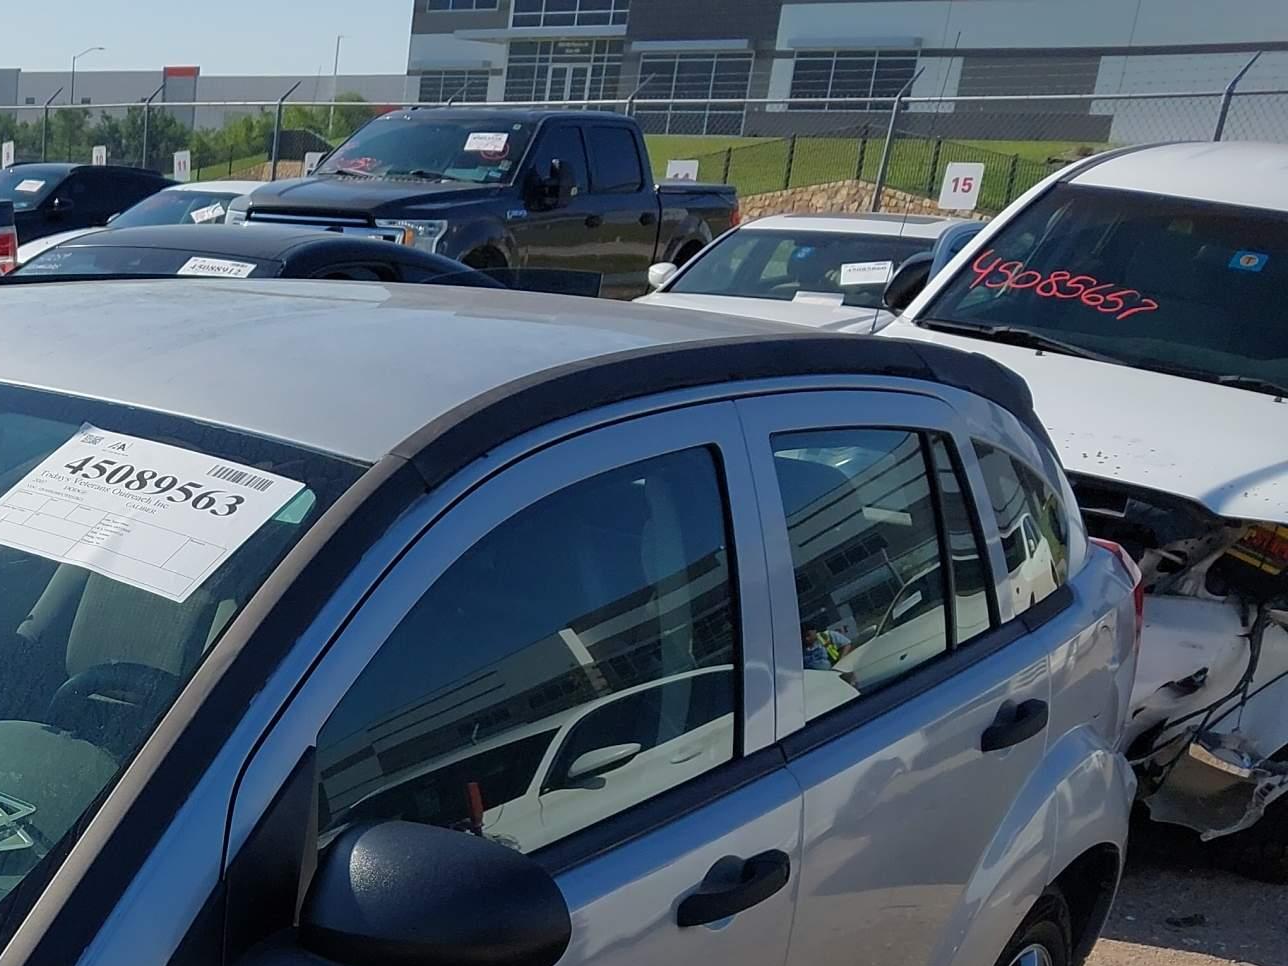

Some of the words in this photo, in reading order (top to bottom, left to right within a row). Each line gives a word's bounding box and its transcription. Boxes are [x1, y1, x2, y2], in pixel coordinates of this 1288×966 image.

[951, 176, 974, 193] 15
[64, 455, 245, 517] 45089563
[112, 486, 153, 506] Outreach
